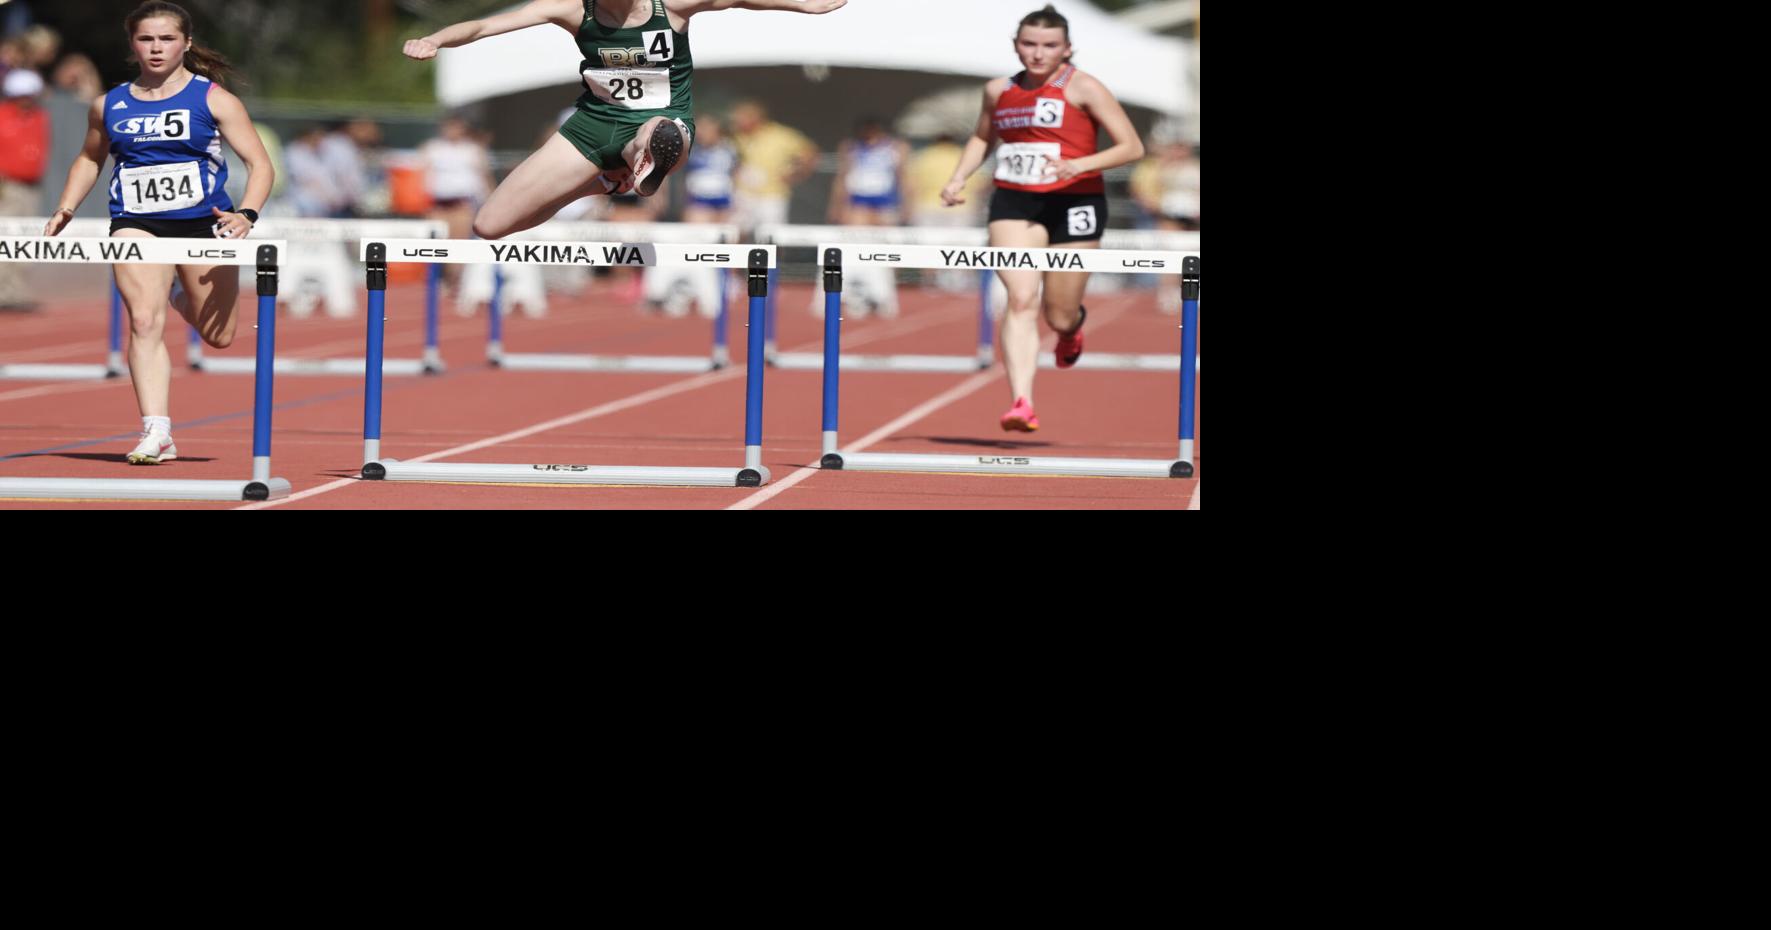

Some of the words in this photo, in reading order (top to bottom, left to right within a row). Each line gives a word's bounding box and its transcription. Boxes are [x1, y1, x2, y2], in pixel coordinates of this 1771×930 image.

[648, 31, 671, 59] 4
[608, 77, 644, 101] 28
[1040, 101, 1057, 125] 3
[163, 111, 184, 138] 5
[131, 174, 194, 204] 1434
[1073, 209, 1090, 231] 3
[99, 242, 143, 261] WA
[187, 249, 237, 259] UCS
[402, 248, 449, 258] UCS
[489, 244, 595, 265] YAKIMA,
[602, 246, 645, 265] WA
[684, 253, 731, 263] UCS
[858, 253, 902, 262] UCS
[940, 249, 1038, 269] YAKIMA,
[1045, 252, 1084, 269] WA
[1122, 259, 1165, 268] UCS
